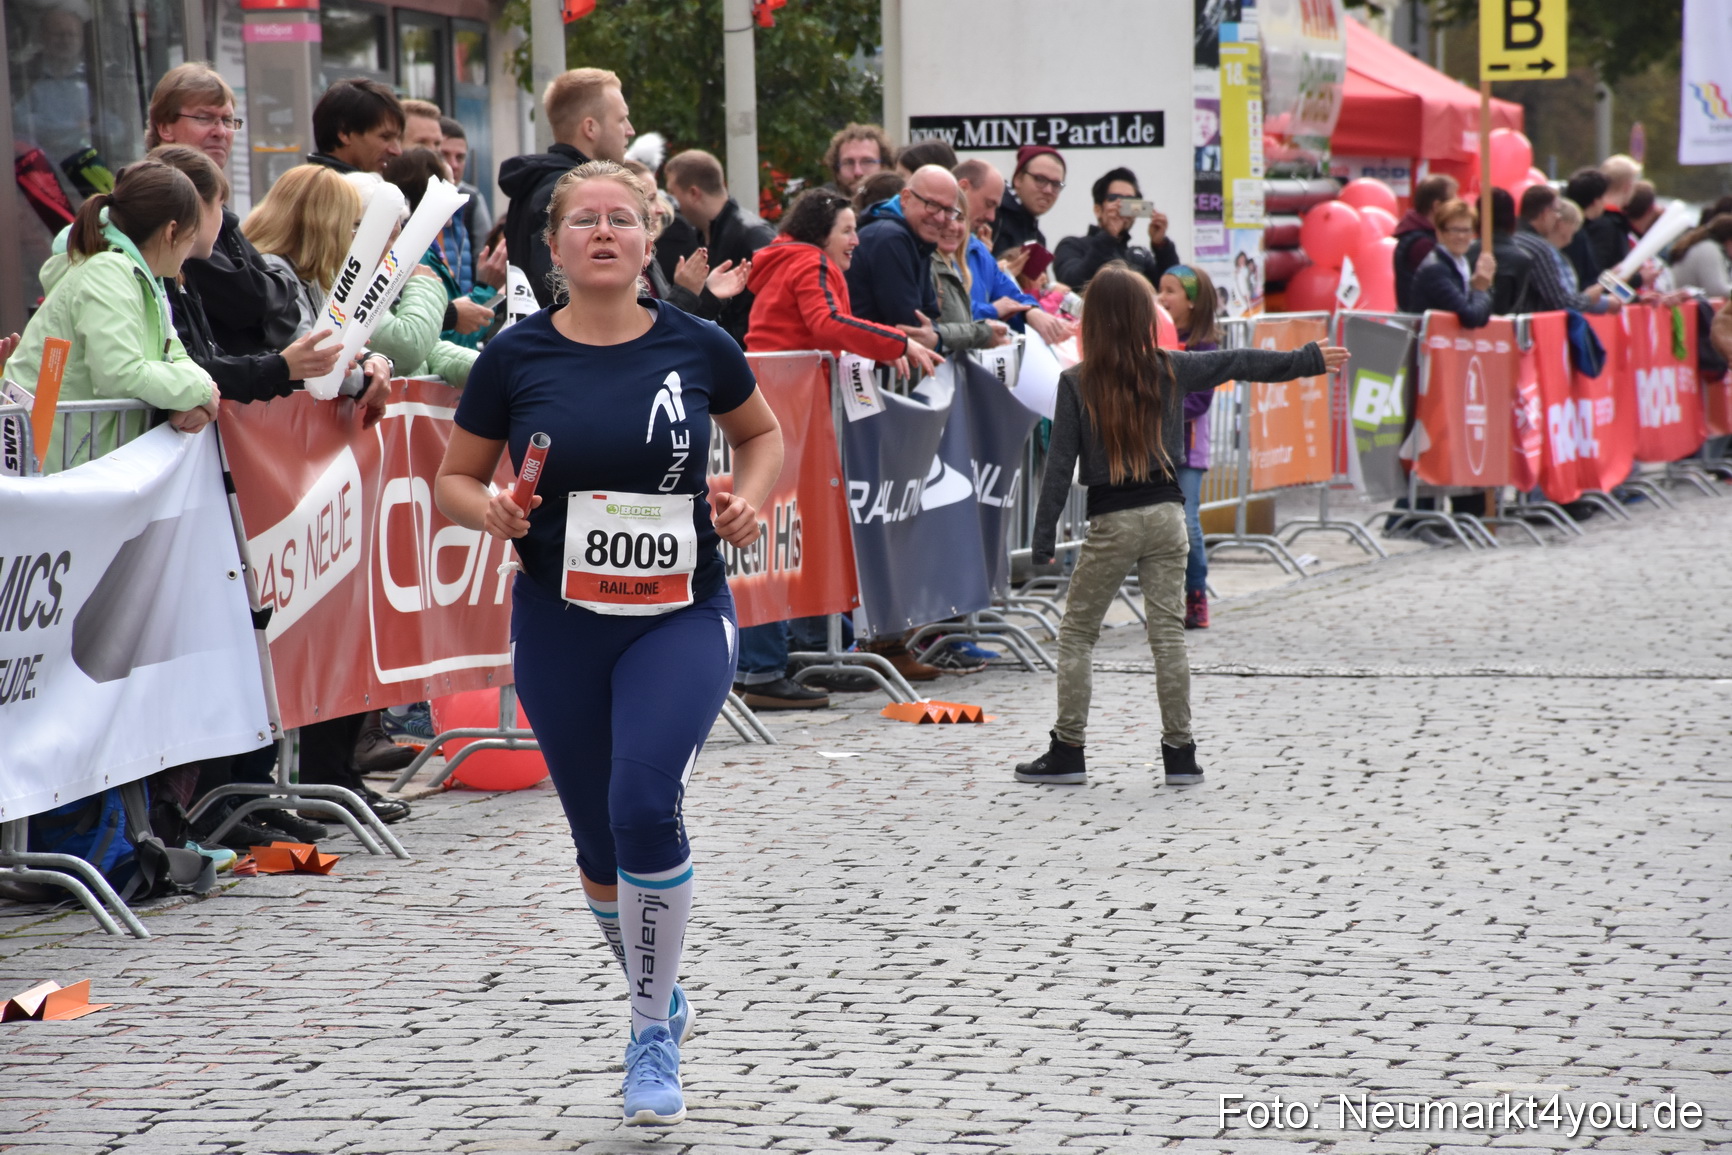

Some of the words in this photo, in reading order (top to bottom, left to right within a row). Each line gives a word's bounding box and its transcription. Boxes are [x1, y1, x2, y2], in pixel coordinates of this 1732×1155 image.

[1503, 0, 1544, 51] B
[353, 273, 390, 324] swn
[4, 417, 18, 472] swn
[658, 429, 691, 492] ONE
[522, 458, 541, 483] 8009
[304, 480, 353, 590] NEUE
[619, 504, 662, 517] BOCK
[585, 529, 679, 570] 8009
[599, 580, 660, 596] RAIL.ONE
